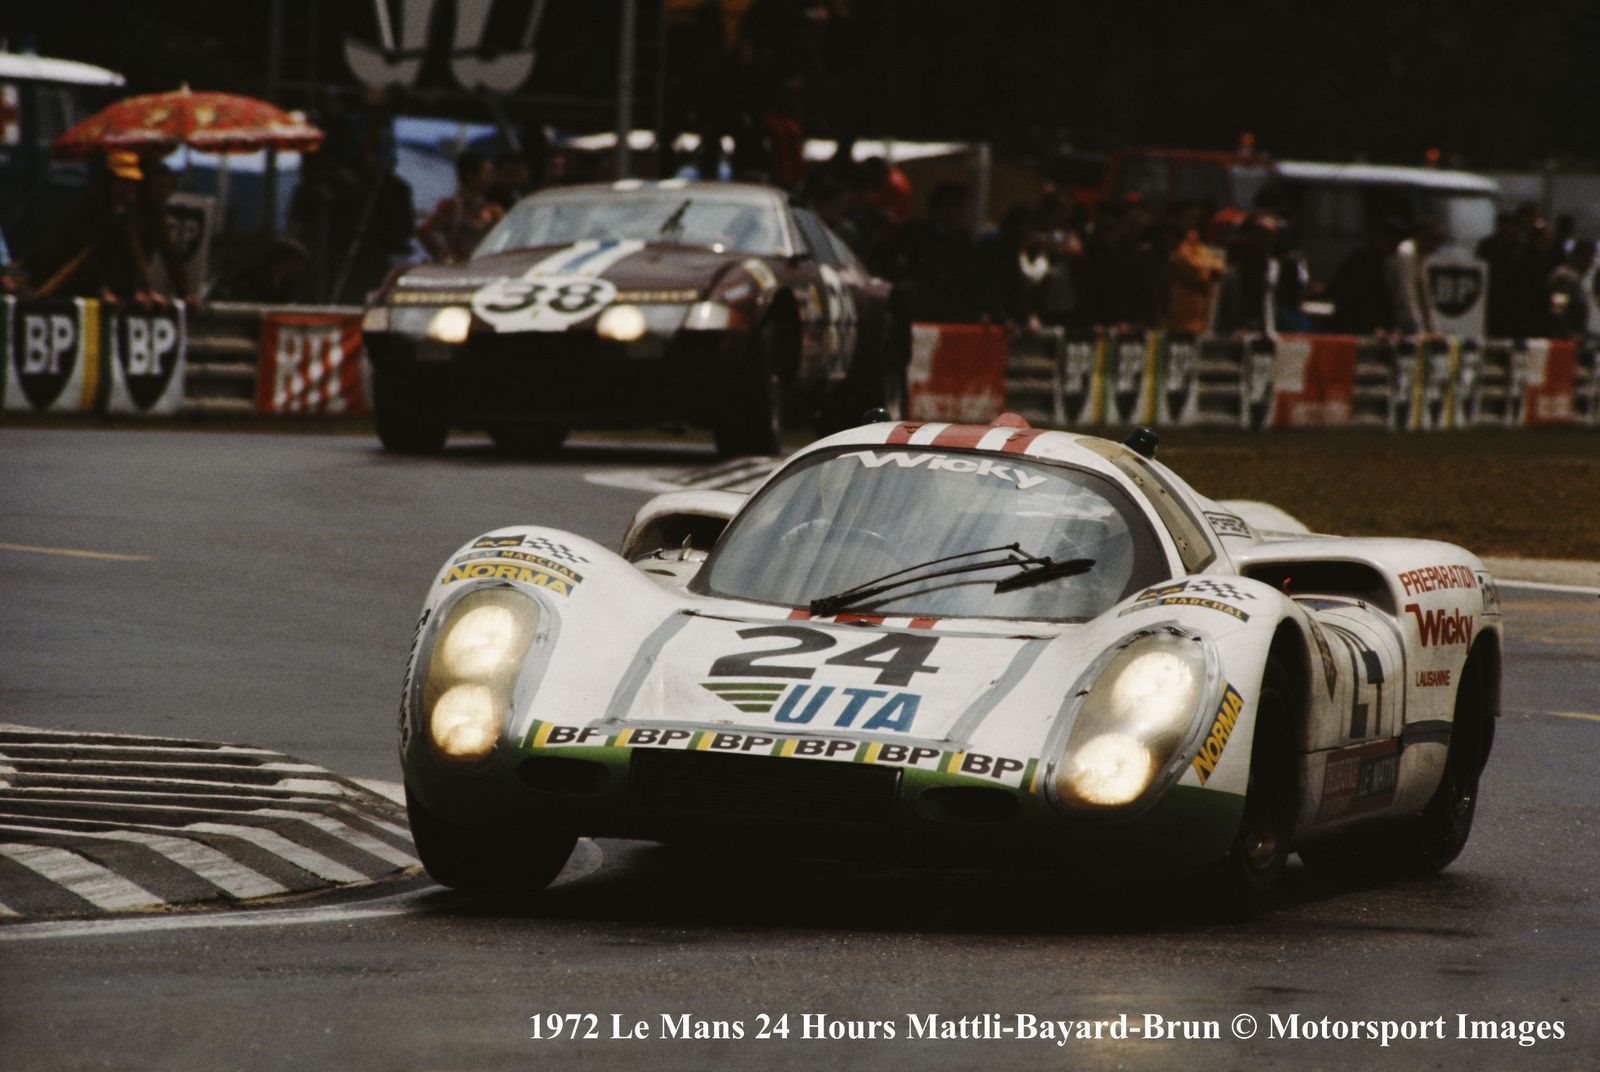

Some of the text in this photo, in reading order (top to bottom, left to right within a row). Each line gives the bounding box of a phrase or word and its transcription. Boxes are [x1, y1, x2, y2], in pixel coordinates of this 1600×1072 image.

[484, 283, 605, 314] 38
[23, 314, 75, 375] BP
[127, 316, 176, 376] BP
[838, 449, 1049, 490] Wicky
[442, 563, 570, 597] NORMA
[500, 550, 577, 580] MARCHAL
[1398, 565, 1477, 597] PREPARATION
[1163, 597, 1244, 619] MARCHAL
[1405, 603, 1473, 656] Wicky
[708, 625, 940, 687] 24
[1415, 670, 1451, 687] LAUSANNE
[774, 684, 922, 733] UTA
[628, 728, 691, 746] BP
[710, 733, 773, 751] BP
[794, 739, 857, 757] BP
[878, 745, 941, 765] BP
[961, 753, 1025, 779] BP
[1191, 690, 1244, 787] NORMA
